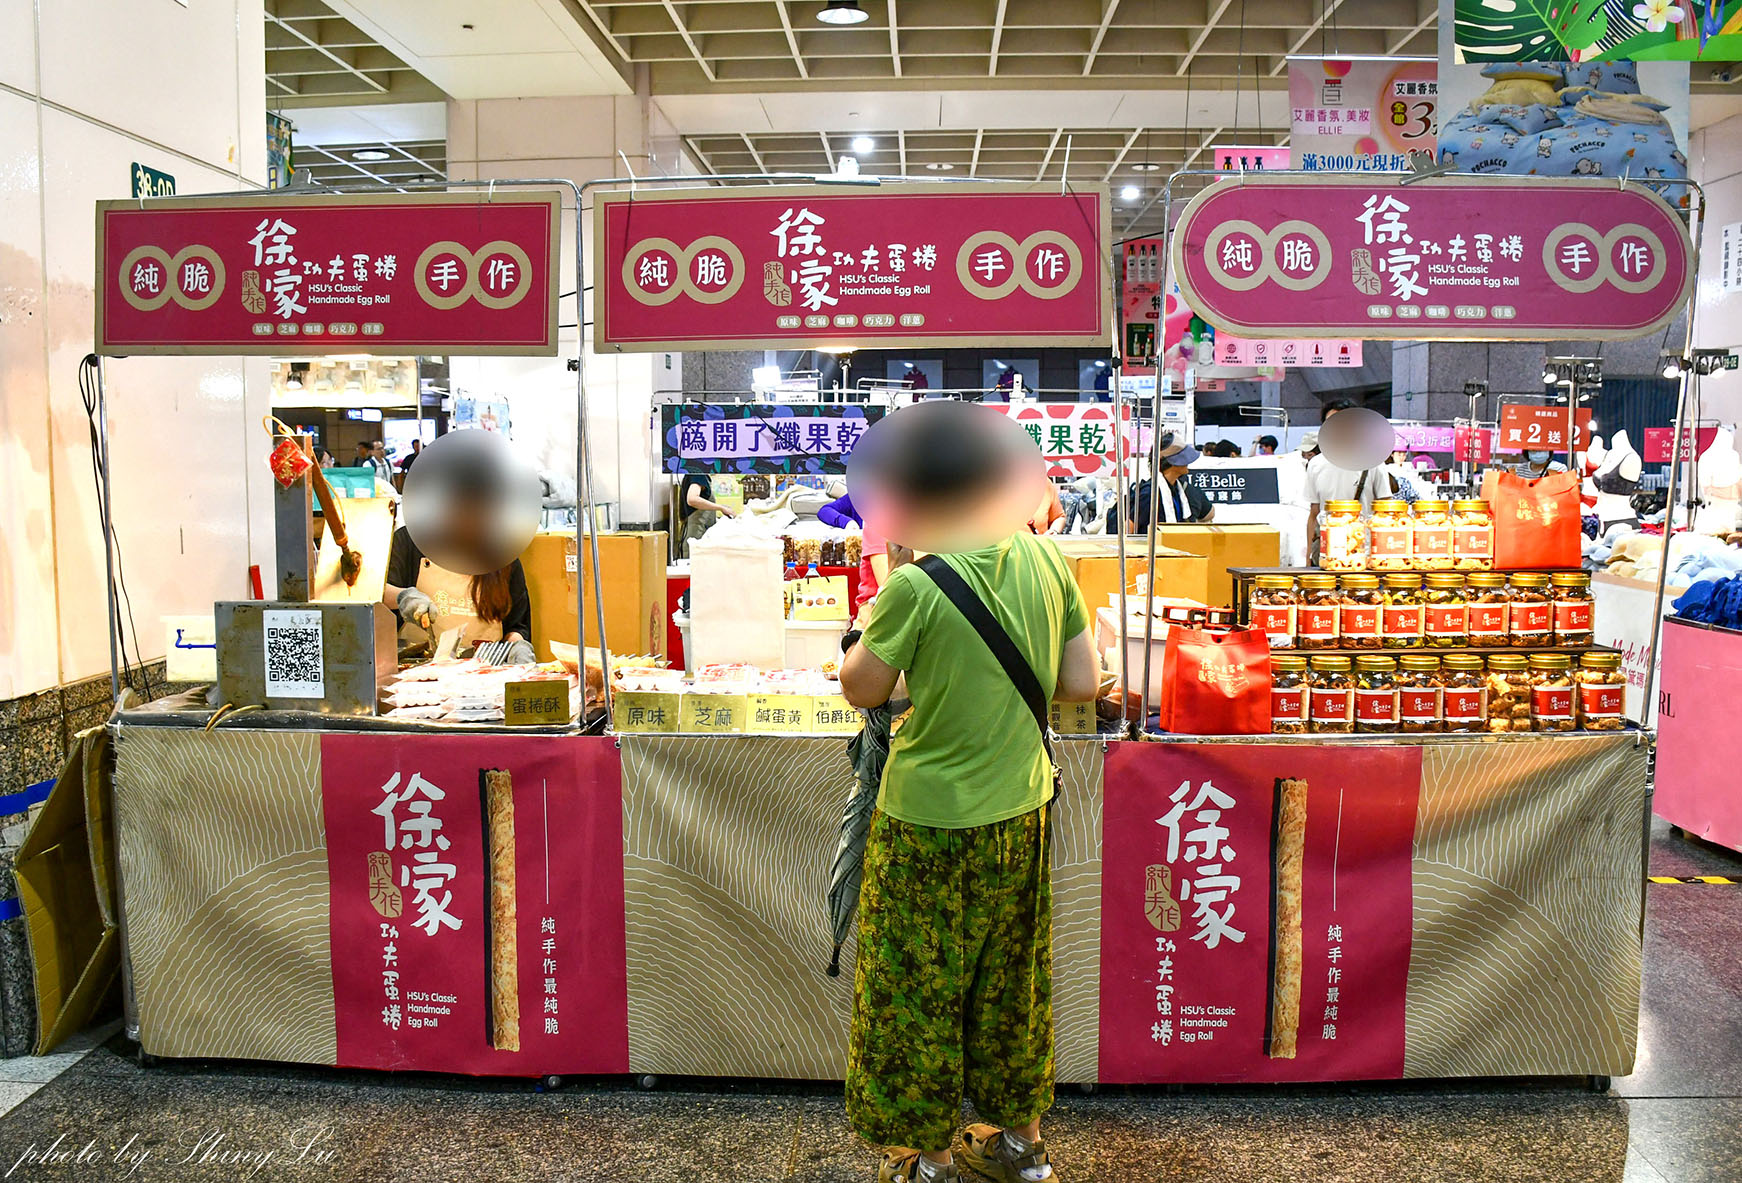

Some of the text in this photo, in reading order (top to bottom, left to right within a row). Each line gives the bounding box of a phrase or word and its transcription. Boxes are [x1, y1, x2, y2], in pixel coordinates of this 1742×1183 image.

[1395, 83, 1438, 95] 艾麗香氛
[1402, 101, 1438, 139] 3
[1318, 126, 1342, 135] ELLIE
[1570, 141, 1606, 154] POCHACCO
[1471, 158, 1508, 173] POCHACCO
[1223, 240, 1313, 271] 純脆
[1355, 194, 1428, 301] 徐家
[1419, 234, 1523, 263] 功夫蛋捲
[769, 208, 838, 311] 徐家
[832, 244, 937, 272] 功夫蛋捲
[974, 249, 1064, 281] 手作
[1561, 242, 1648, 273] 手作
[133, 262, 210, 293] 純脆
[248, 218, 307, 319] 徐家
[302, 254, 397, 282] 功夫蛋捲
[431, 259, 515, 291] 手作
[639, 254, 726, 286] 純脆
[1428, 264, 1488, 273] HSU's Classic
[308, 284, 363, 292] HSU's Classic
[840, 274, 900, 283] HSU's Classic
[1429, 277, 1519, 288] Handmade Egg Roll
[308, 295, 390, 305] Handmade Egg Roll
[840, 285, 931, 296] Handmade Egg Roll
[1457, 307, 1484, 317] 巧克力
[331, 324, 355, 334] 巧克力
[866, 317, 892, 327] 巧克力
[512, 697, 560, 714] 蛋捲酥
[627, 707, 666, 726] 原味
[694, 707, 732, 726] 芝麻
[755, 708, 802, 726] 鹹蛋黃
[371, 772, 463, 936] 徐家
[1155, 780, 1246, 949] 徐家
[369, 853, 401, 917] 純手作
[1145, 866, 1179, 931] 純手作
[380, 923, 402, 1030] 功夫蛋捲
[541, 917, 559, 1034] 純手作最純脆
[1322, 925, 1343, 1040] 純手作最純脆
[407, 992, 457, 1004] HSU's Classic
[1151, 937, 1176, 1046] 功夫蛋捲
[407, 1004, 451, 1015] Handmade
[1180, 1005, 1236, 1016] HSU's Classic
[408, 1017, 438, 1028] Egg Roll
[1180, 1017, 1228, 1027] Handmade
[1180, 1030, 1213, 1042] Egg Roll
